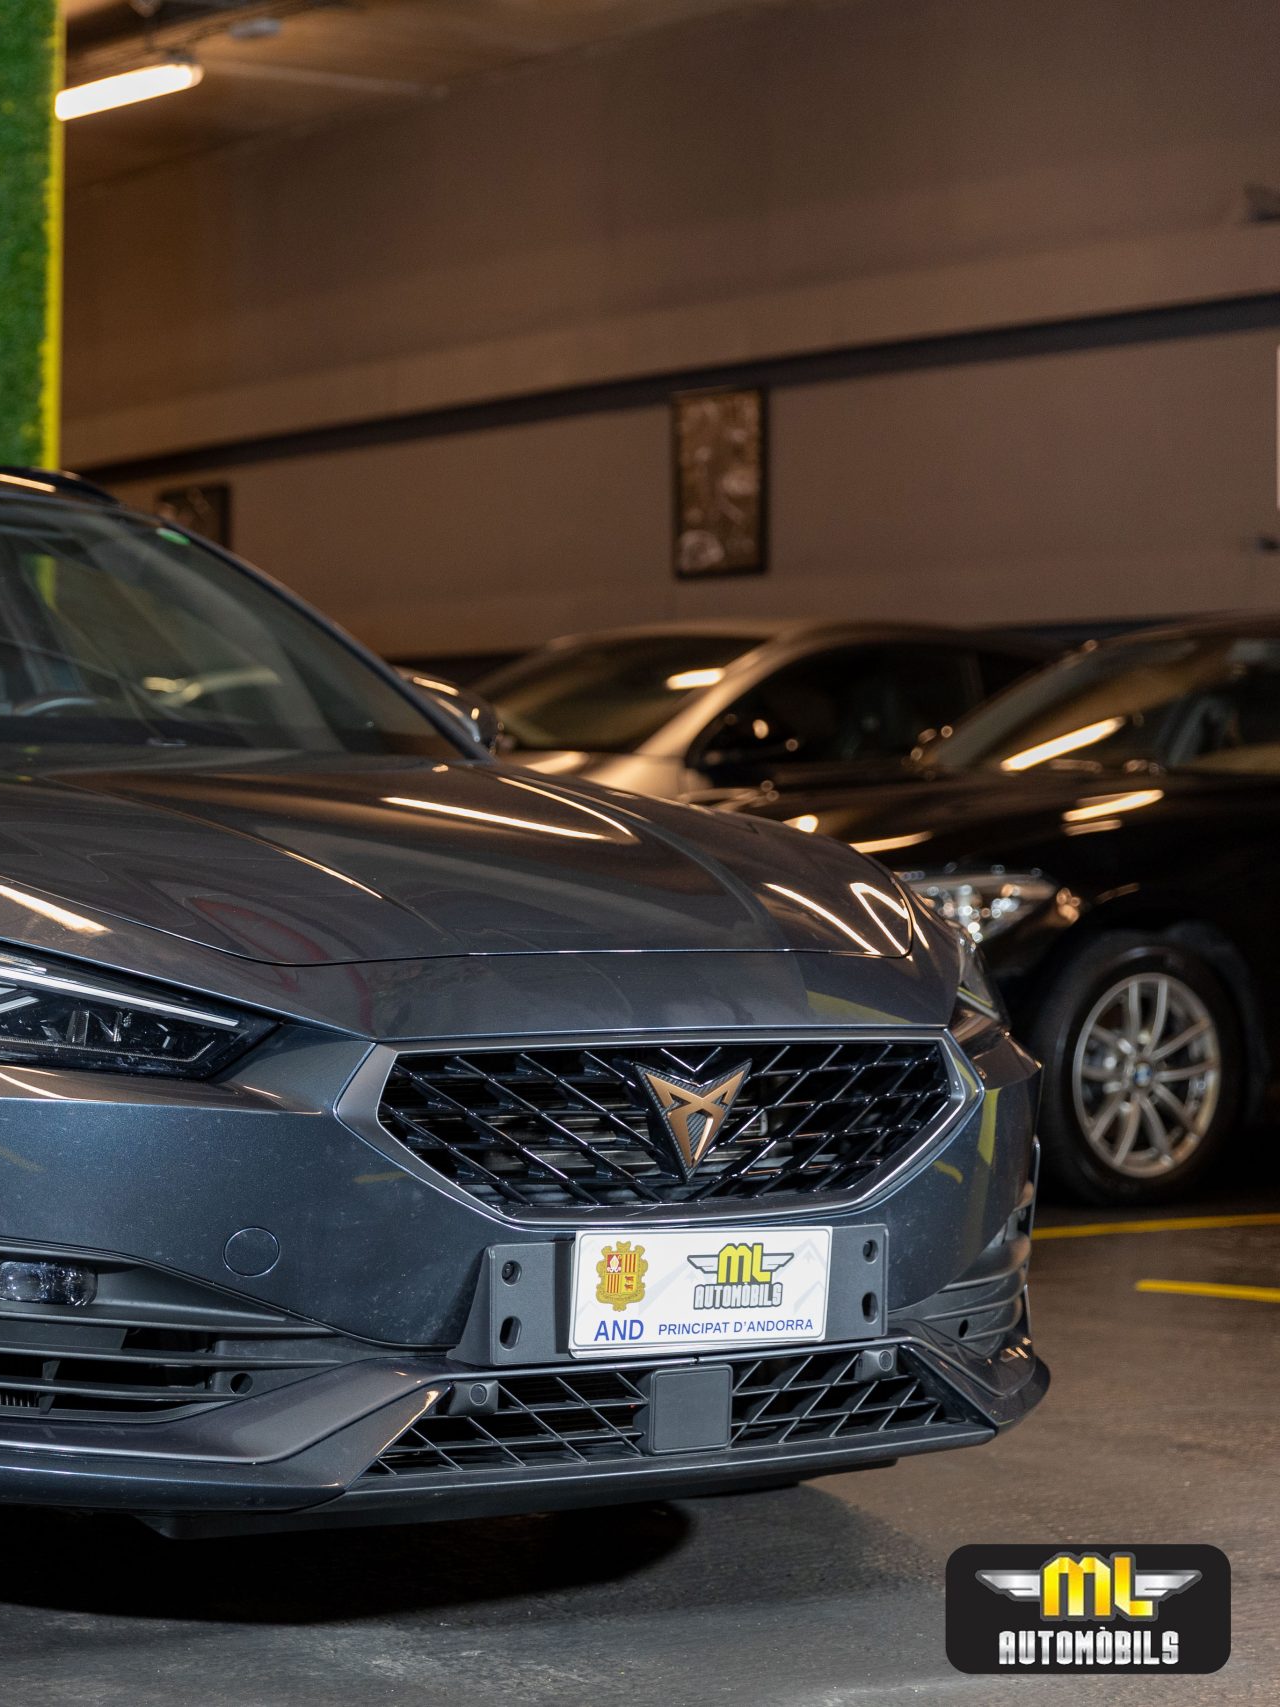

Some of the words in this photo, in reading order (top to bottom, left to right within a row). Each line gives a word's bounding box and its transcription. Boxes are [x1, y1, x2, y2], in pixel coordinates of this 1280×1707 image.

[718, 1243, 772, 1283] ML
[594, 1319, 644, 1341] AND
[658, 1321, 730, 1336] PRINCIPAT
[733, 1318, 814, 1333] D'ANDORRA
